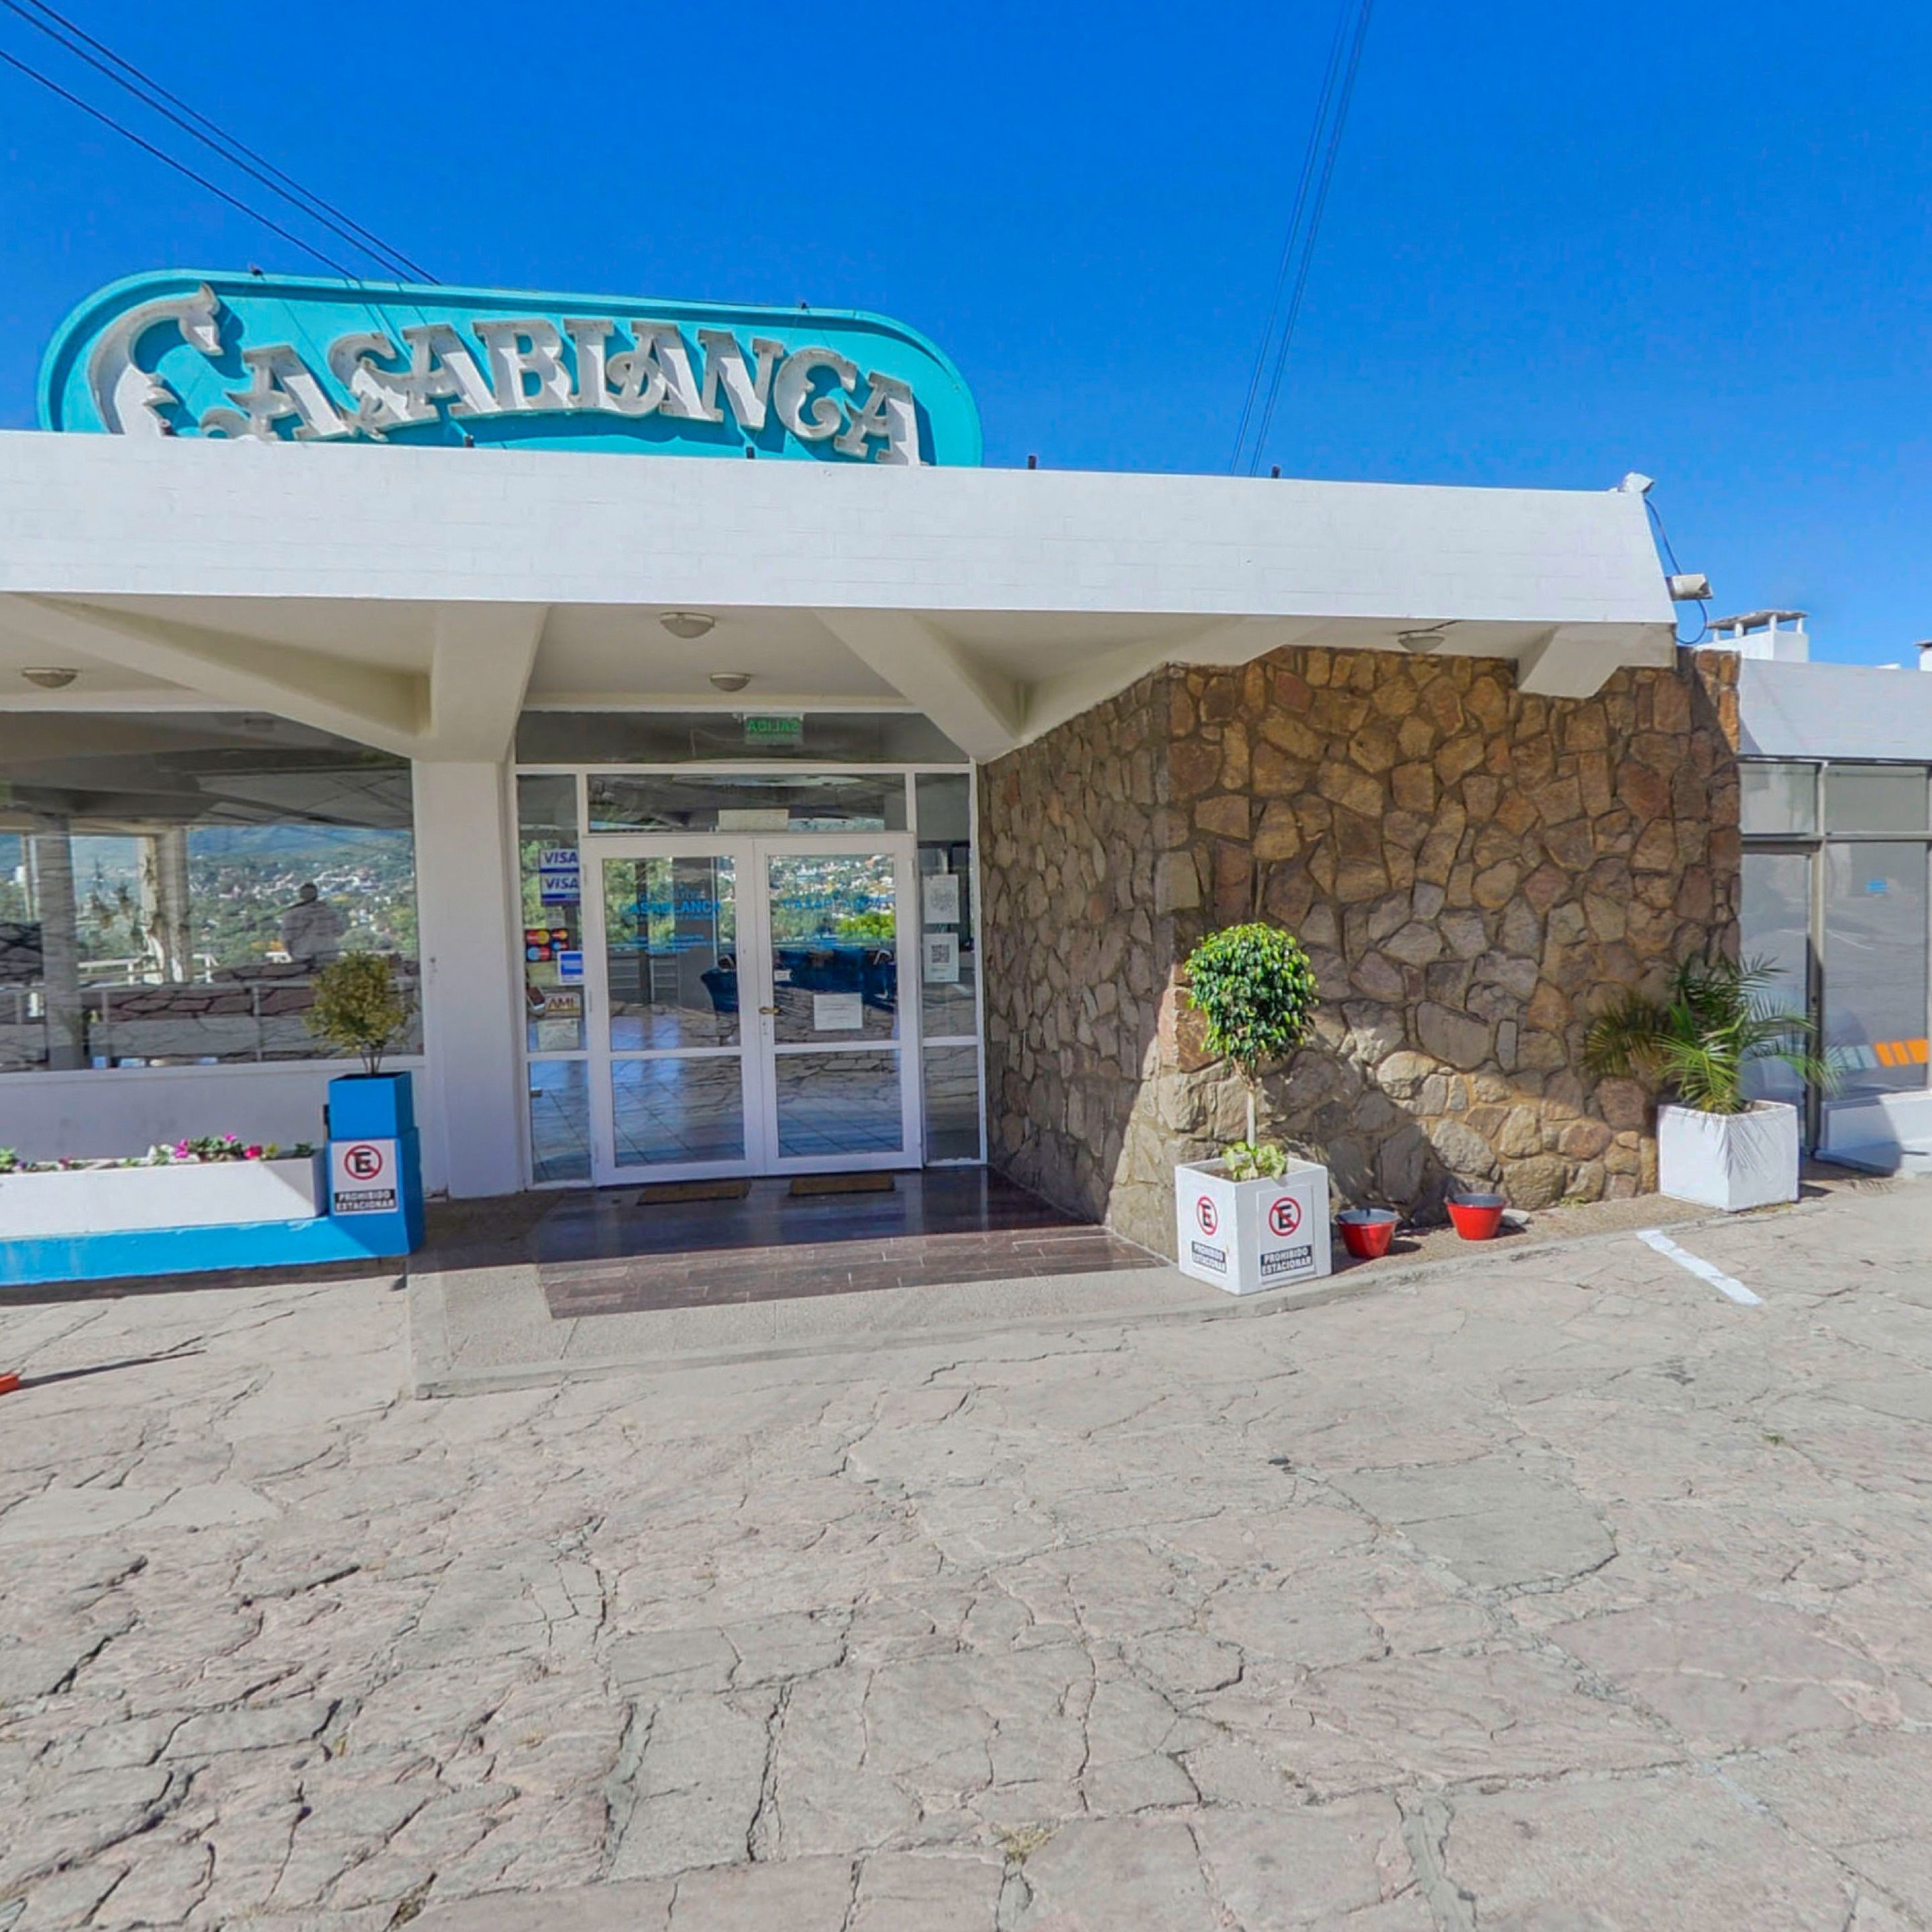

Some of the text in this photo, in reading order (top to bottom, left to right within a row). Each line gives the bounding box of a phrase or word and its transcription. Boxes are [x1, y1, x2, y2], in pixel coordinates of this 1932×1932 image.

[87, 281, 930, 466] CASABLANCA
[544, 851, 578, 863] VISA
[545, 877, 579, 889] VISA
[1264, 1246, 1308, 1265] PROHIBIDO
[1262, 1256, 1311, 1274] ESTACIONAR
